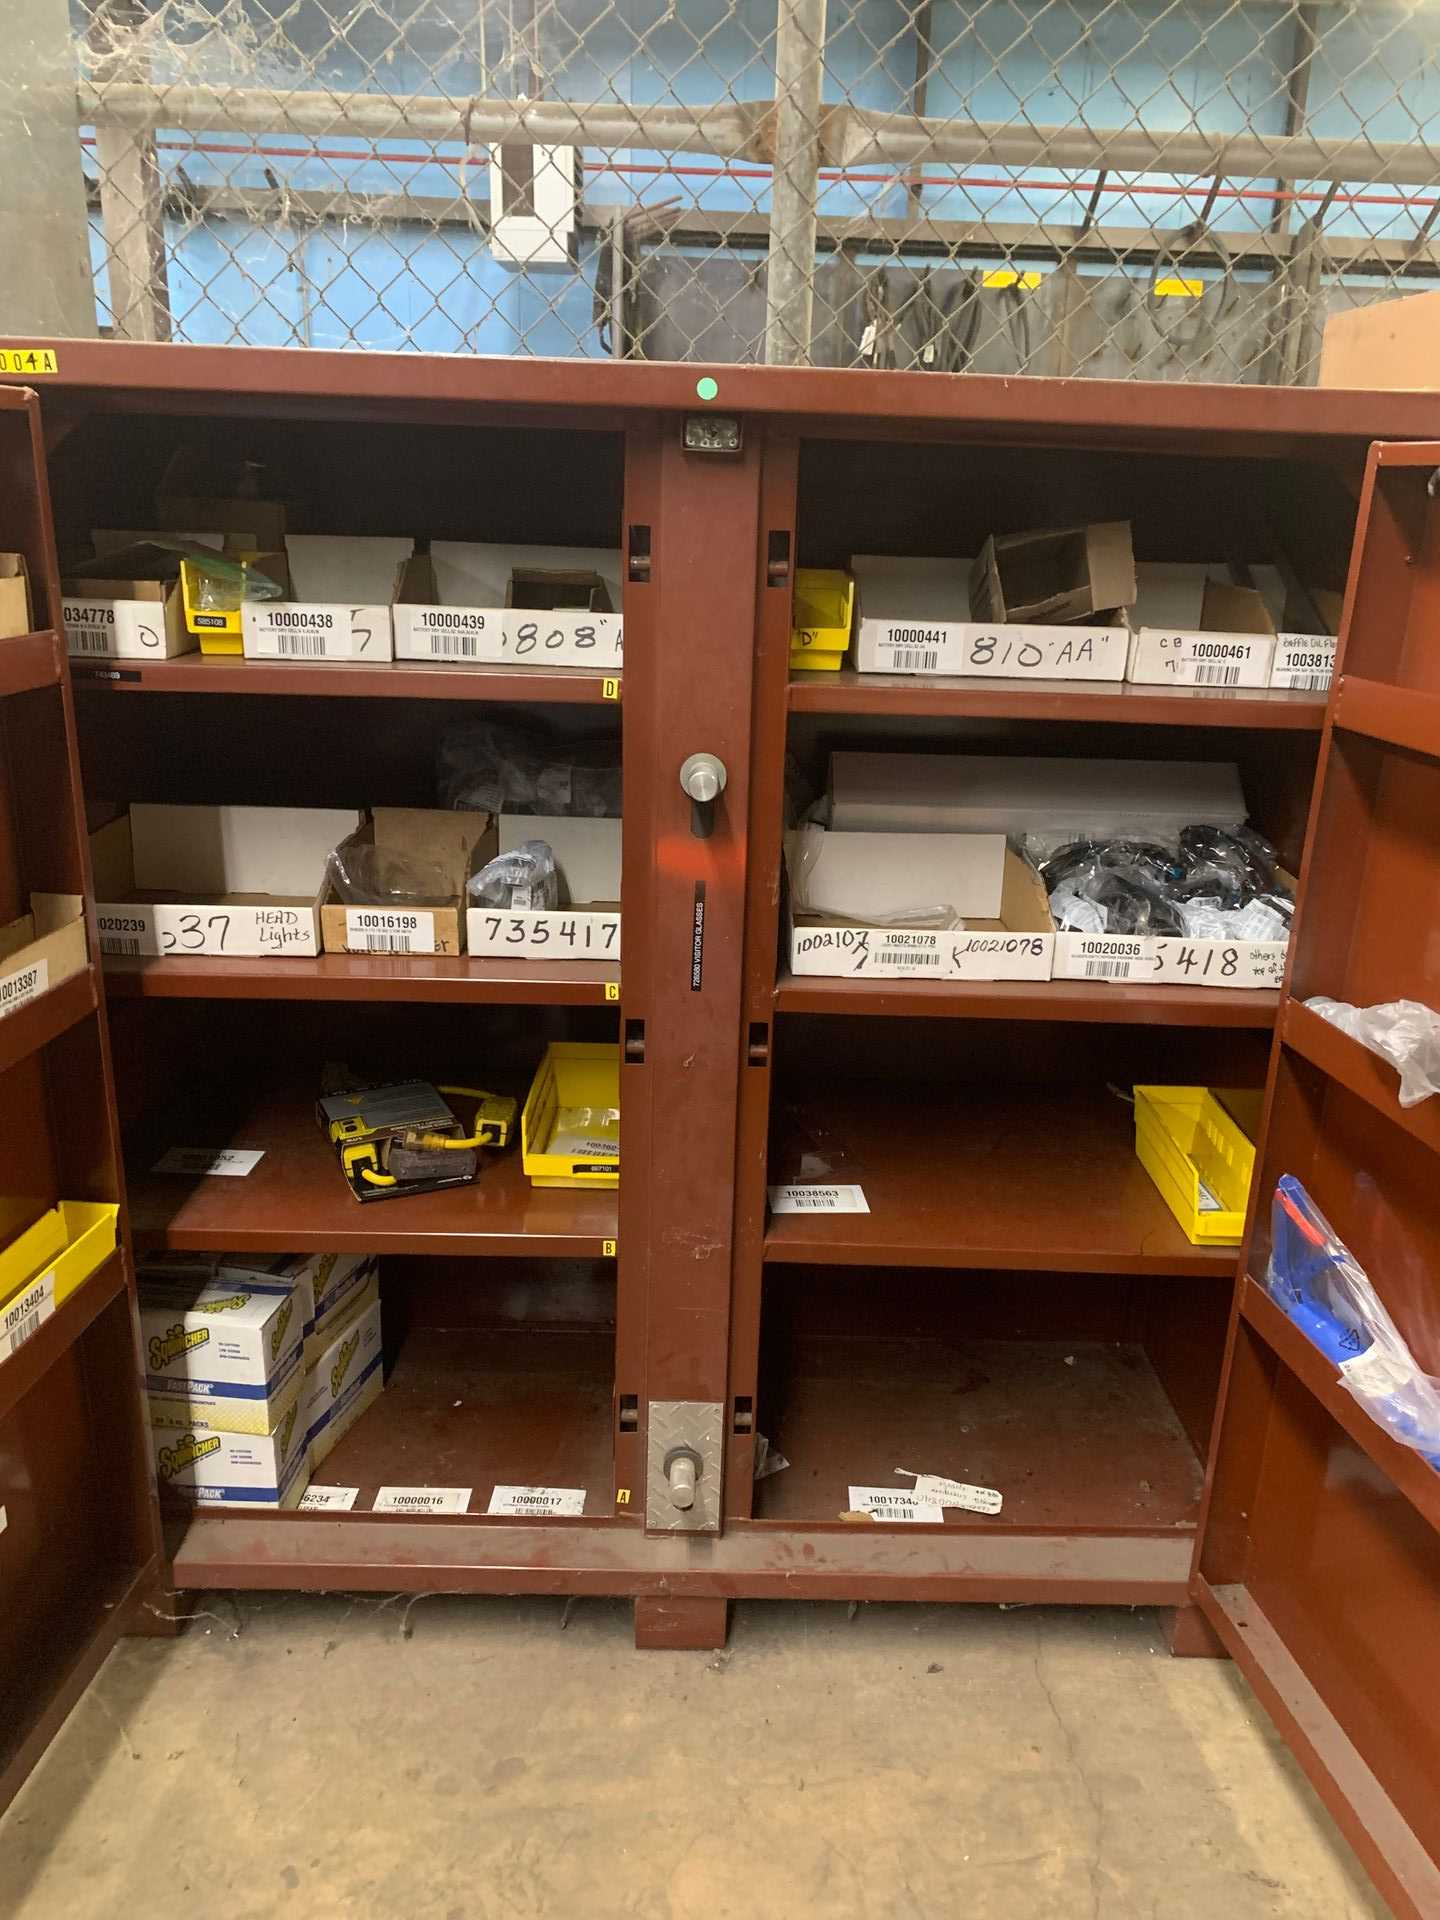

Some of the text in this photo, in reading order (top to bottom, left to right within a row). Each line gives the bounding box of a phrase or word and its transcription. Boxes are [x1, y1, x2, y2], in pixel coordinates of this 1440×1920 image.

[63, 606, 115, 624] 034778
[267, 612, 334, 629] 10000438
[421, 612, 486, 630] 10000439
[887, 628, 947, 644] 10000441
[970, 636, 1042, 667] 810
[1192, 643, 1251, 659] 10000461
[606, 680, 614, 696] D
[255, 909, 299, 925] HEAD
[357, 914, 417, 929] 10016198
[695, 902, 704, 935] GLASSES
[885, 934, 937, 945] 10021078
[965, 937, 1044, 957] 10021078
[694, 935, 702, 963] VISITOR
[1081, 941, 1141, 956] 10020036
[605, 1242, 612, 1255] B
[4, 1285, 45, 1329] 10013404
[392, 1496, 444, 1505] 10000016
[511, 1495, 562, 1506] 10000017
[620, 1490, 627, 1503] A
